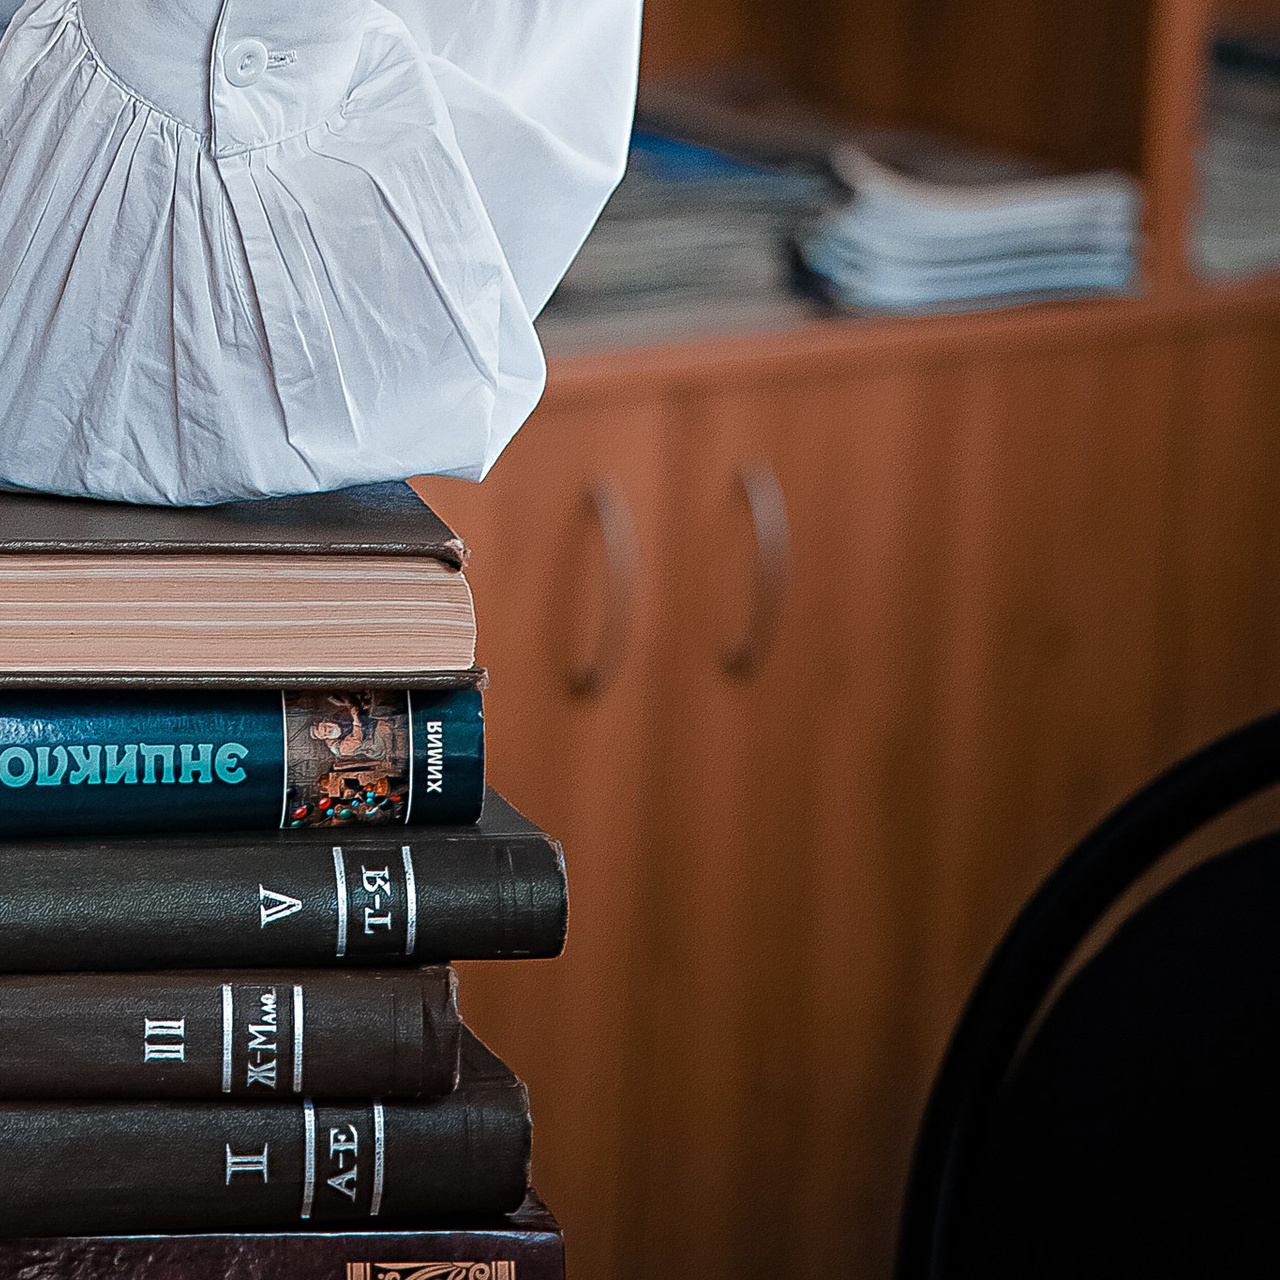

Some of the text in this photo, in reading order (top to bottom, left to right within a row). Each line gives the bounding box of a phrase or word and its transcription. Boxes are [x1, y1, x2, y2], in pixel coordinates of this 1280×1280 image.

[426, 721, 443, 793] ХИМИЯ
[258, 883, 303, 929] V
[144, 1016, 186, 1063] II
